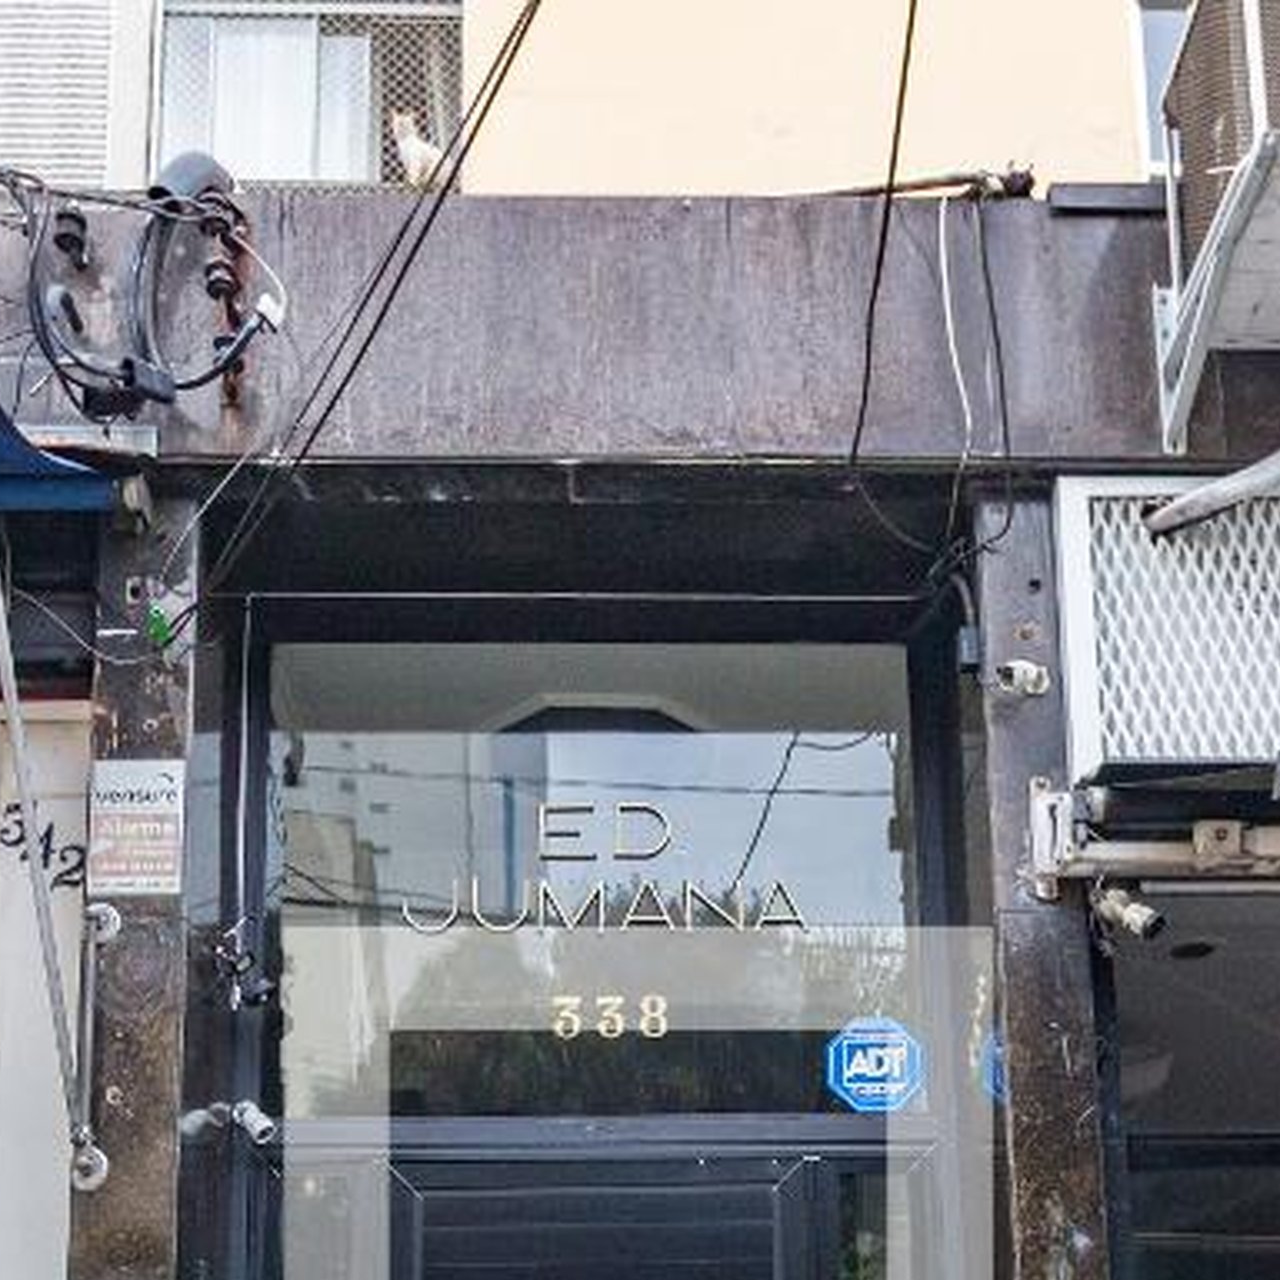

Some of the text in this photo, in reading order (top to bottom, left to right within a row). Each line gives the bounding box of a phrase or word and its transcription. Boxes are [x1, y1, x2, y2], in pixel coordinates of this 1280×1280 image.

[539, 803, 673, 862] ED
[401, 875, 810, 935] JUMANA
[552, 994, 669, 1039] 338
[847, 1046, 906, 1078] ADT
